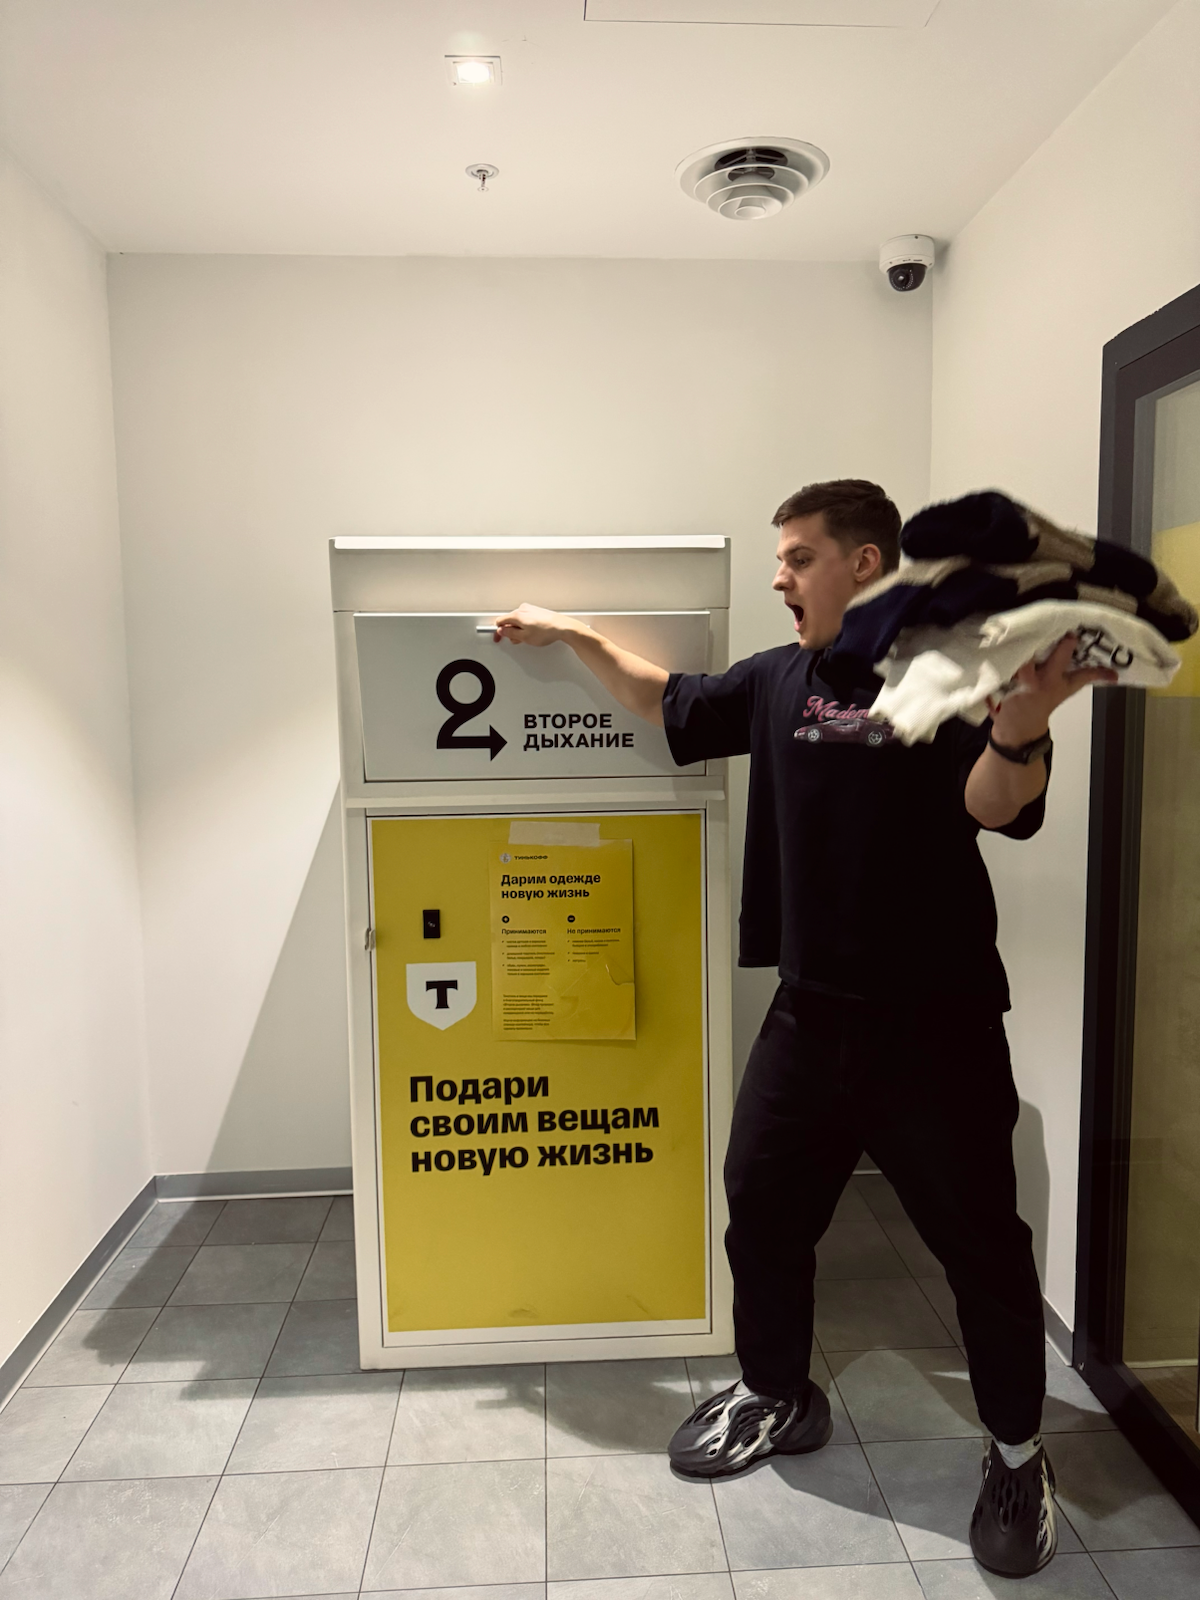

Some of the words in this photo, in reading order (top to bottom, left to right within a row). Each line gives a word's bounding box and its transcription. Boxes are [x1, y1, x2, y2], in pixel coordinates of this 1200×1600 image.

[802, 695, 870, 722] Madem
[524, 713, 612, 729] ВТОРОЕ
[523, 732, 635, 752] ДЫХАНИЕ
[500, 873, 547, 887] Дарим
[549, 873, 601, 886] одежде
[501, 889, 544, 901] новую
[547, 888, 590, 899] жизнь
[501, 928, 547, 936] Принимаются
[576, 927, 621, 936] принимаются
[410, 1075, 549, 1105] Подари
[410, 1110, 529, 1138] своим
[537, 1106, 660, 1134] вещам
[411, 1146, 529, 1177] новую
[537, 1142, 654, 1167] жизнь
